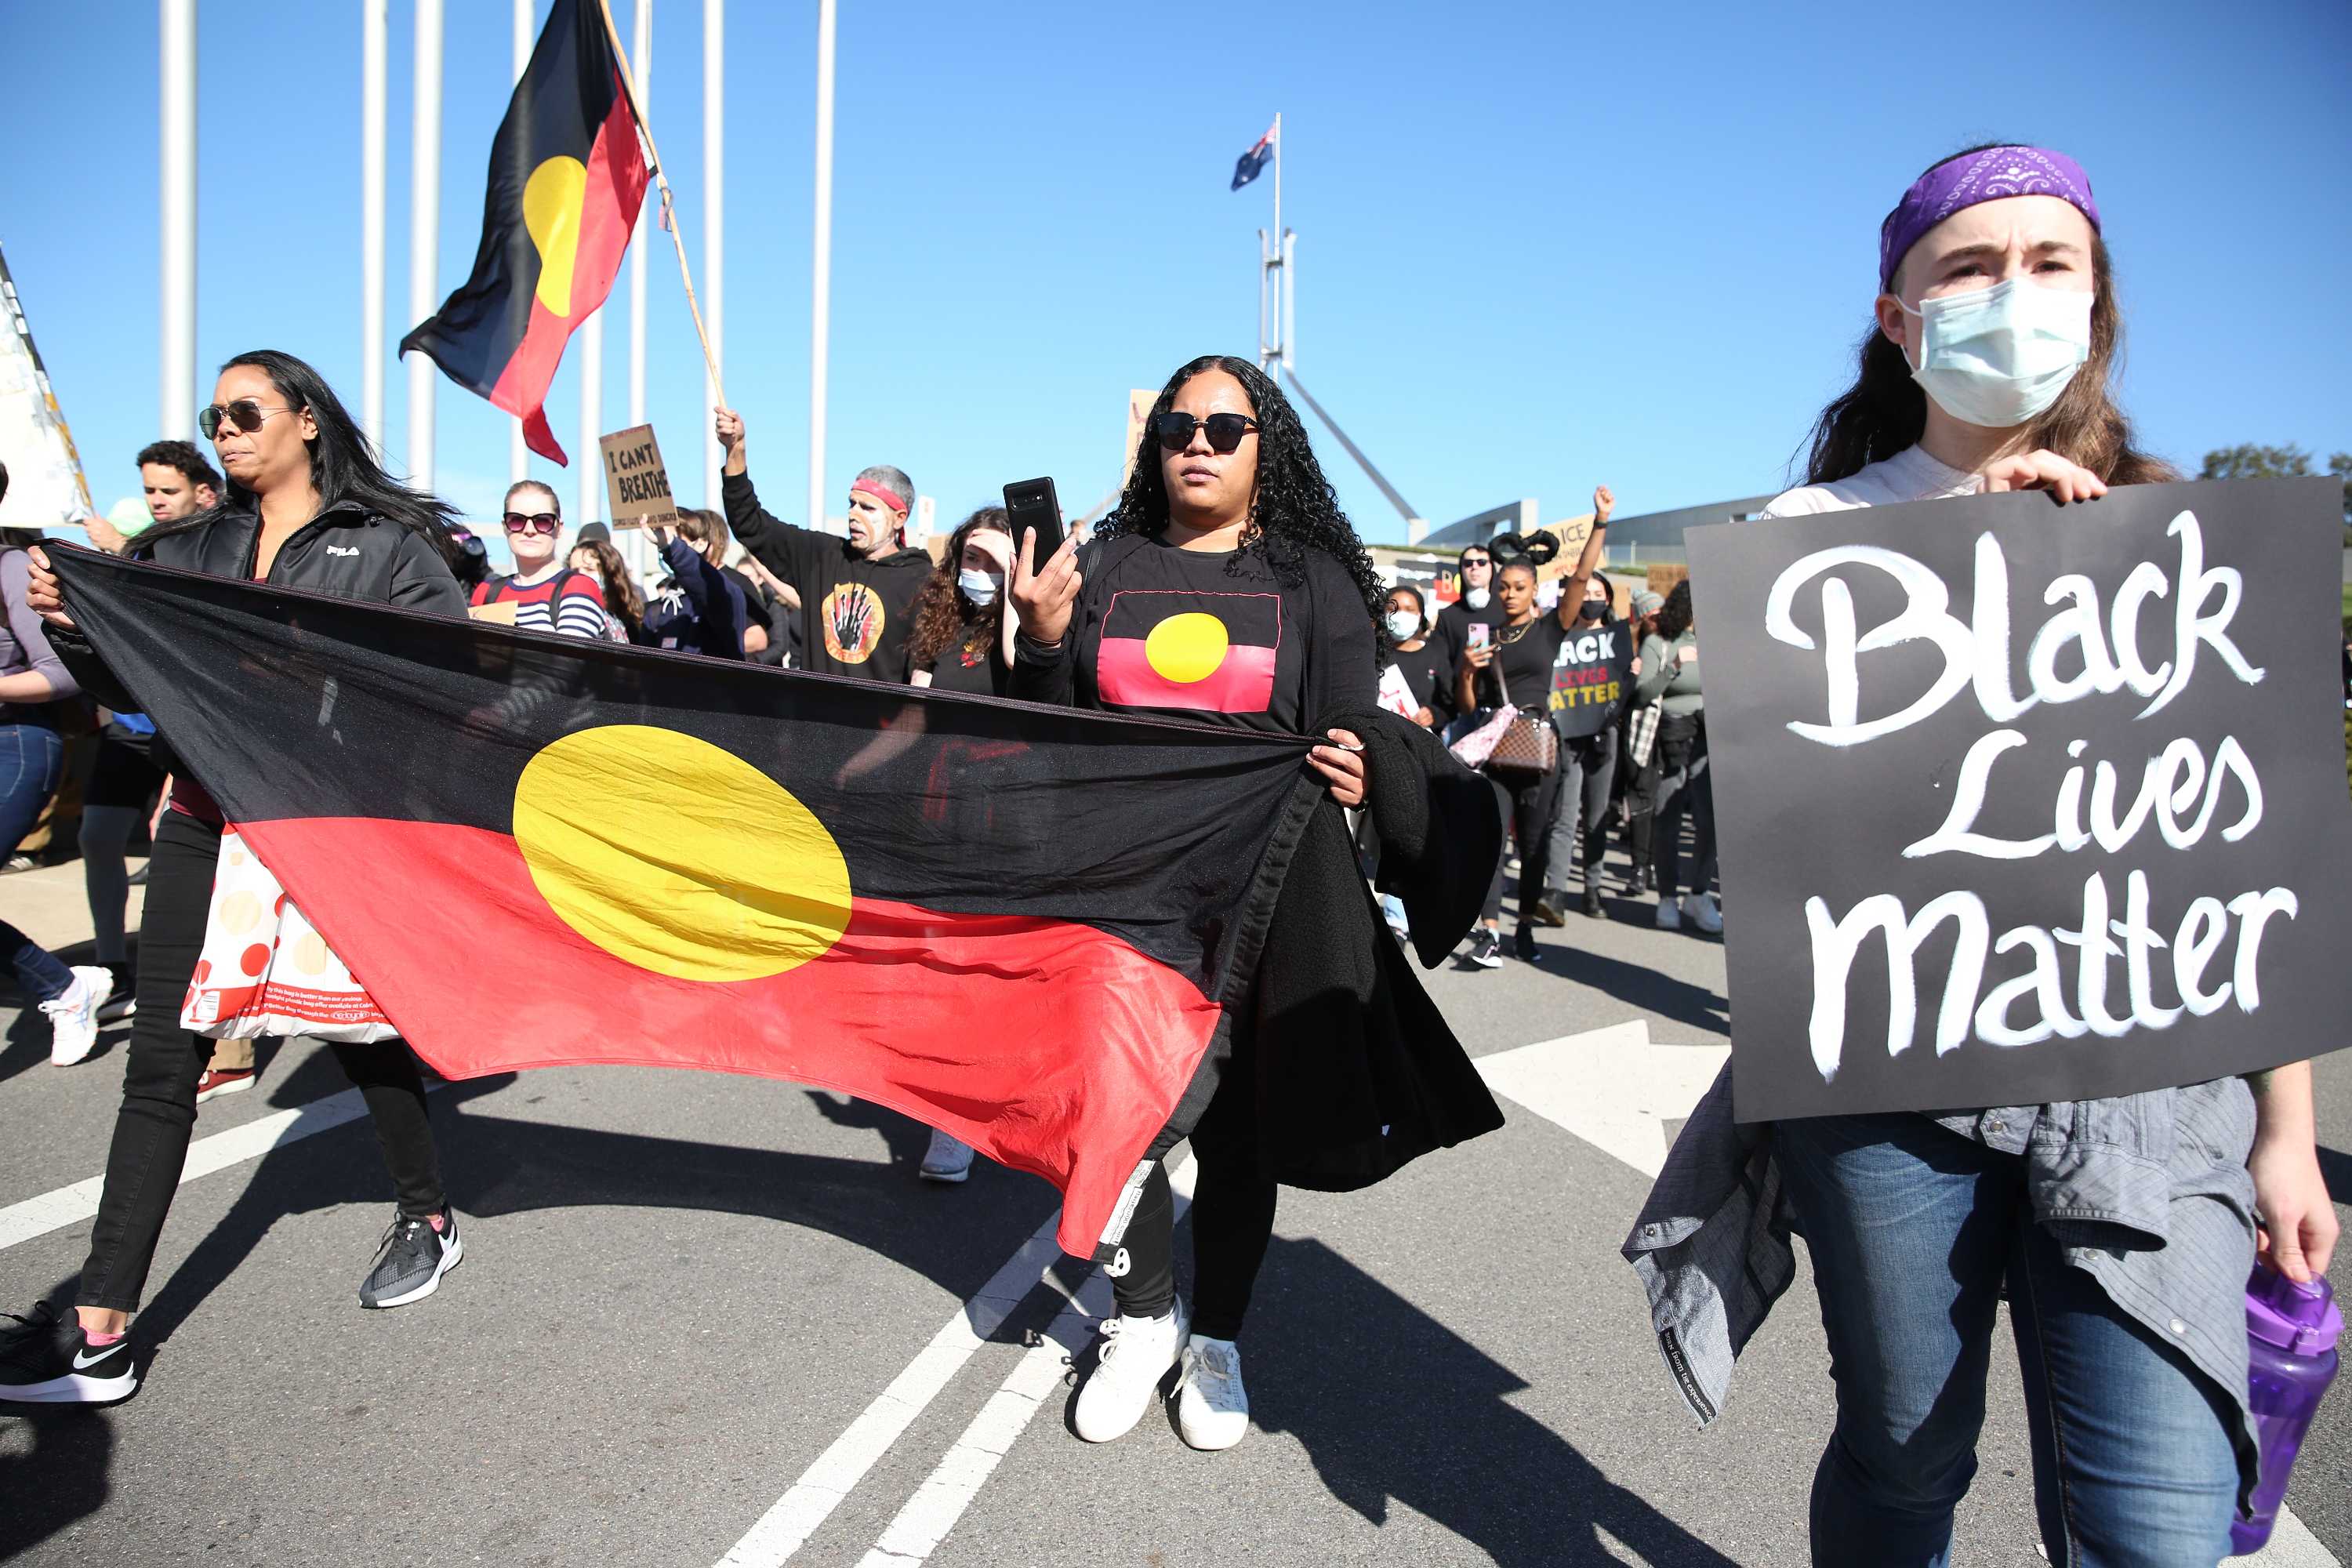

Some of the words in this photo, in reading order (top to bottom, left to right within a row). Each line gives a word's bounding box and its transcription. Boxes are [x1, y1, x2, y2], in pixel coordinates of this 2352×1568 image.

[608, 451, 618, 473] I
[618, 469, 672, 503] BREATHE
[326, 545, 360, 557] FILA
[1766, 510, 2265, 746] Black
[1553, 631, 1616, 667] ACK
[1555, 666, 1608, 688] LIVES
[1549, 681, 1620, 711] ATTER
[1901, 728, 2263, 859] Lives
